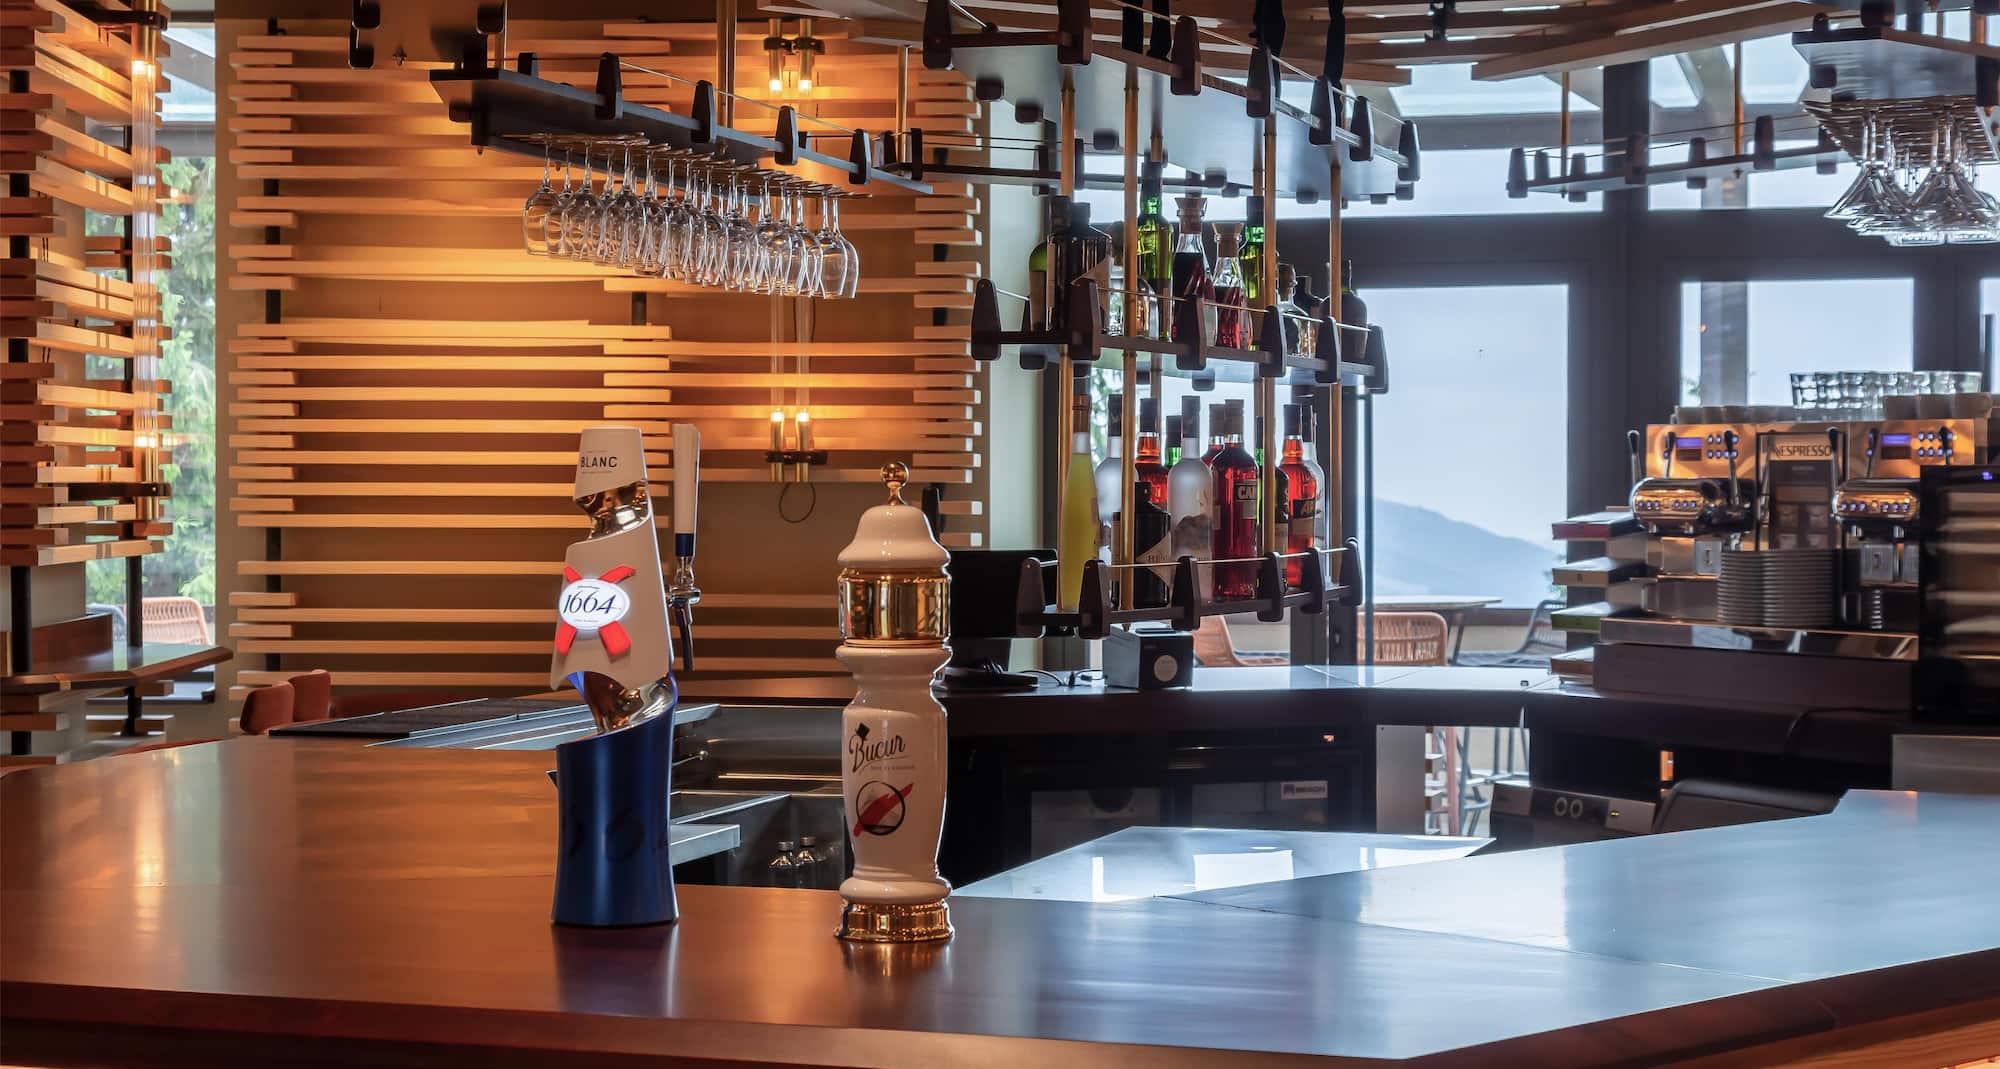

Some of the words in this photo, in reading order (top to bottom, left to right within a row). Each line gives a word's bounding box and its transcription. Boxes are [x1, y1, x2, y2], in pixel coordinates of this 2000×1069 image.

[580, 456, 617, 468] BLANC
[563, 590, 616, 614] 1664
[849, 734, 906, 772] Bucur
